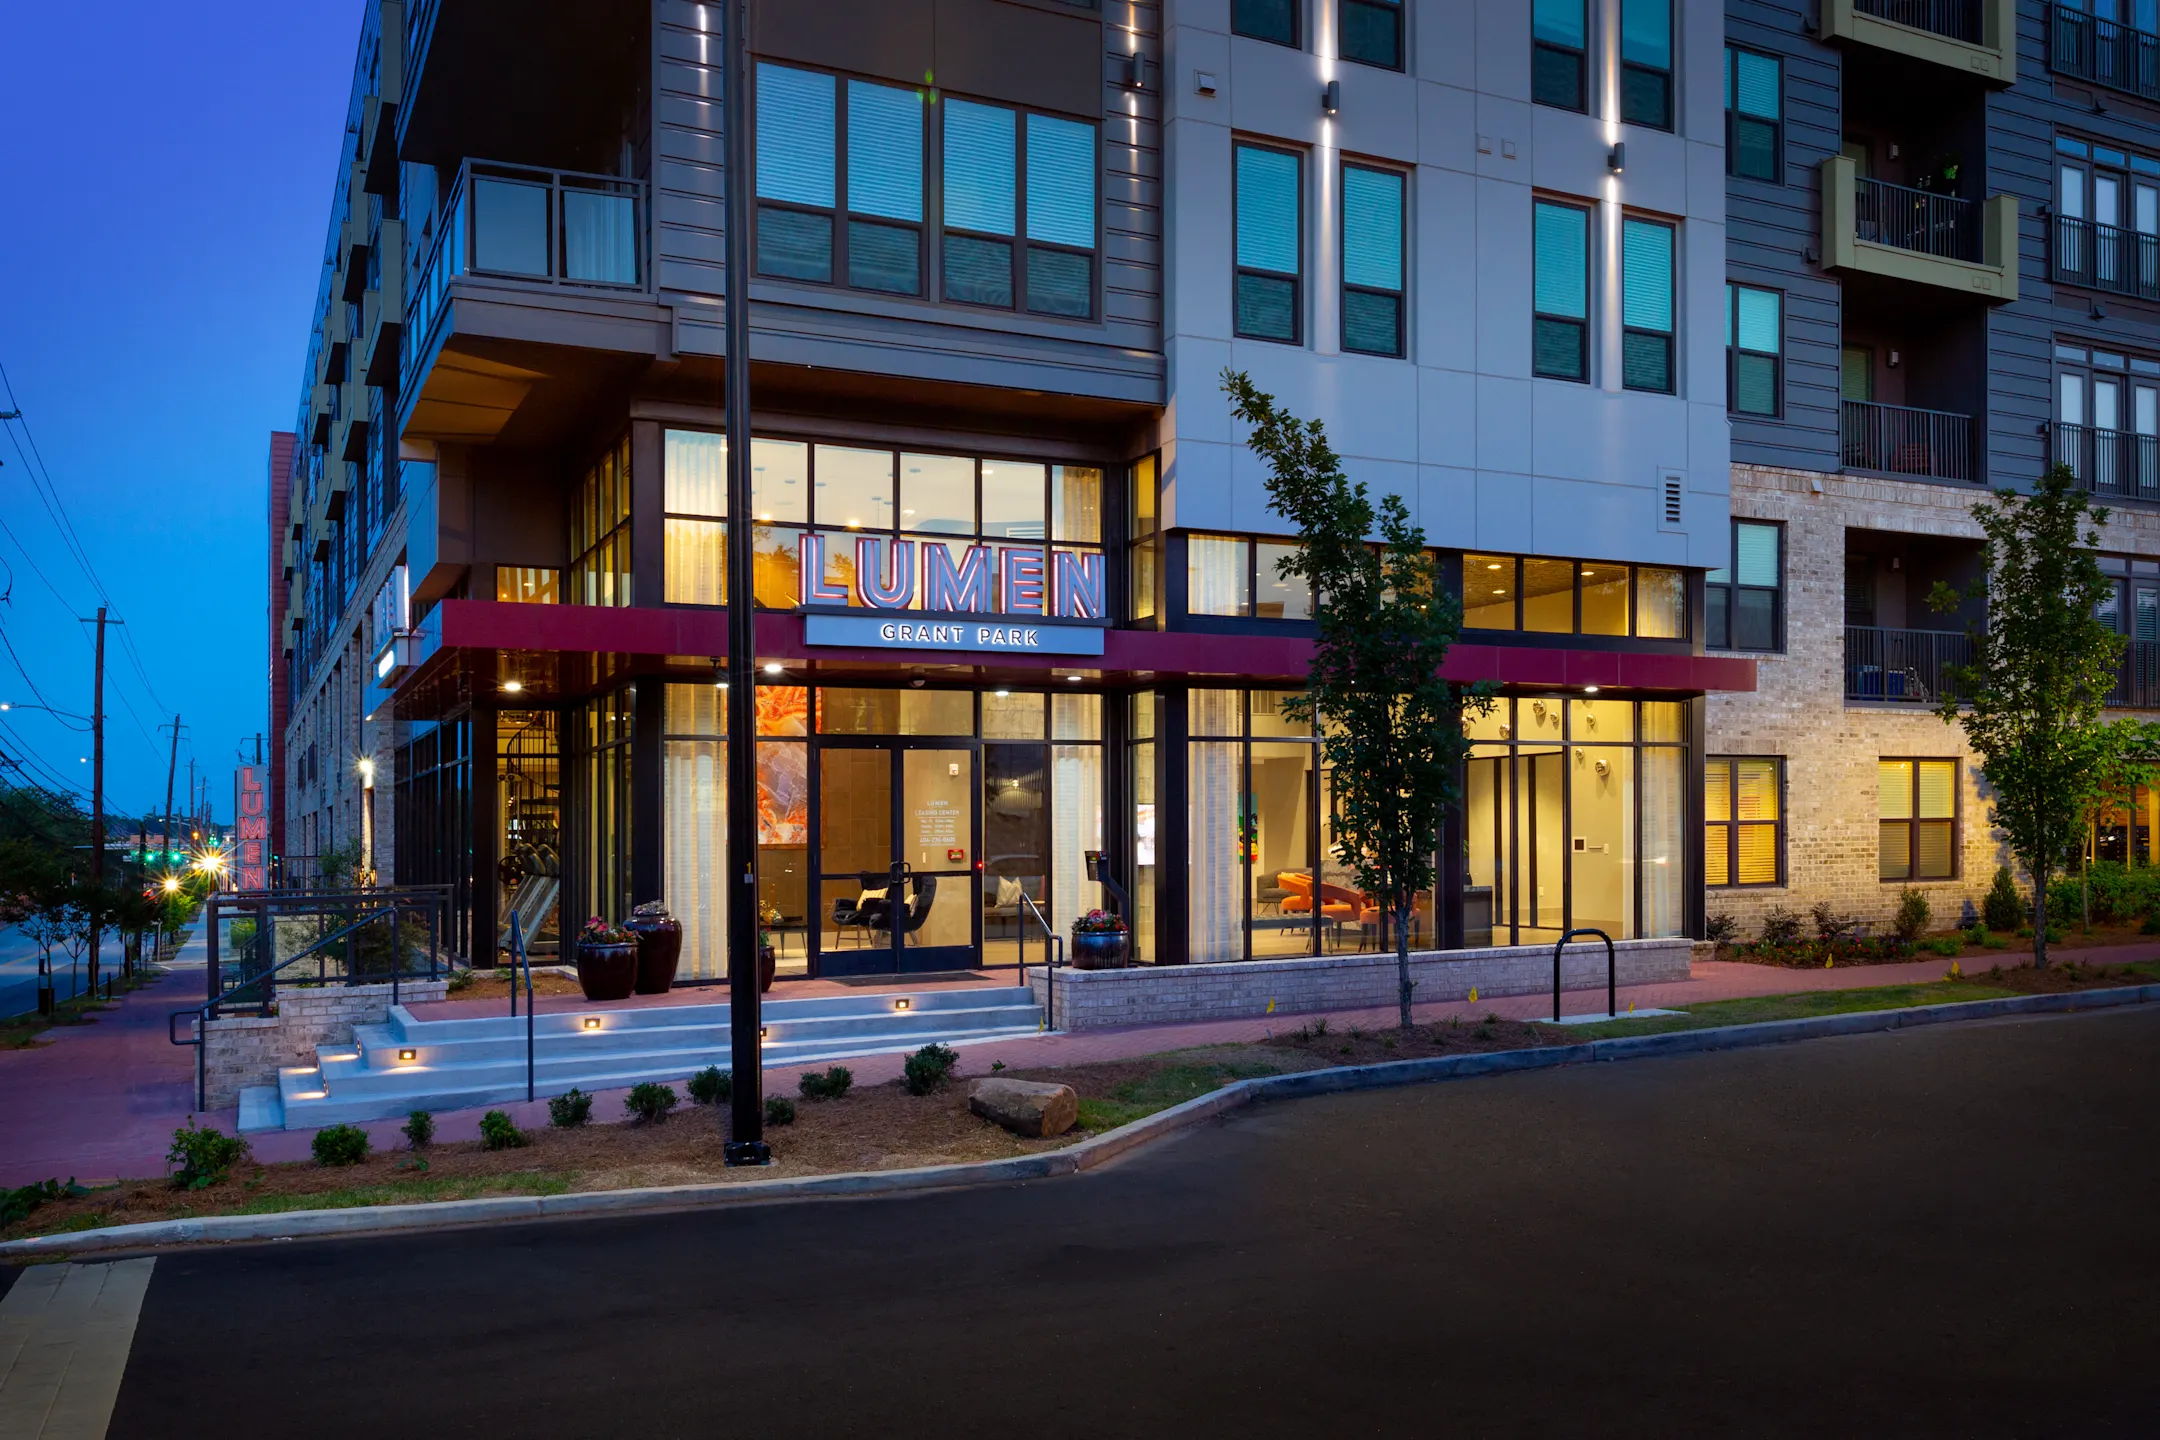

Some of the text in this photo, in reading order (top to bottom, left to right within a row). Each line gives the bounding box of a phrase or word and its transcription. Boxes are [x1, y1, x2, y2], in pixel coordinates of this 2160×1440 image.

[799, 533, 1106, 618] LUMEN
[881, 624, 1039, 646] GRANT PARK
[239, 767, 266, 890] LUMEN
